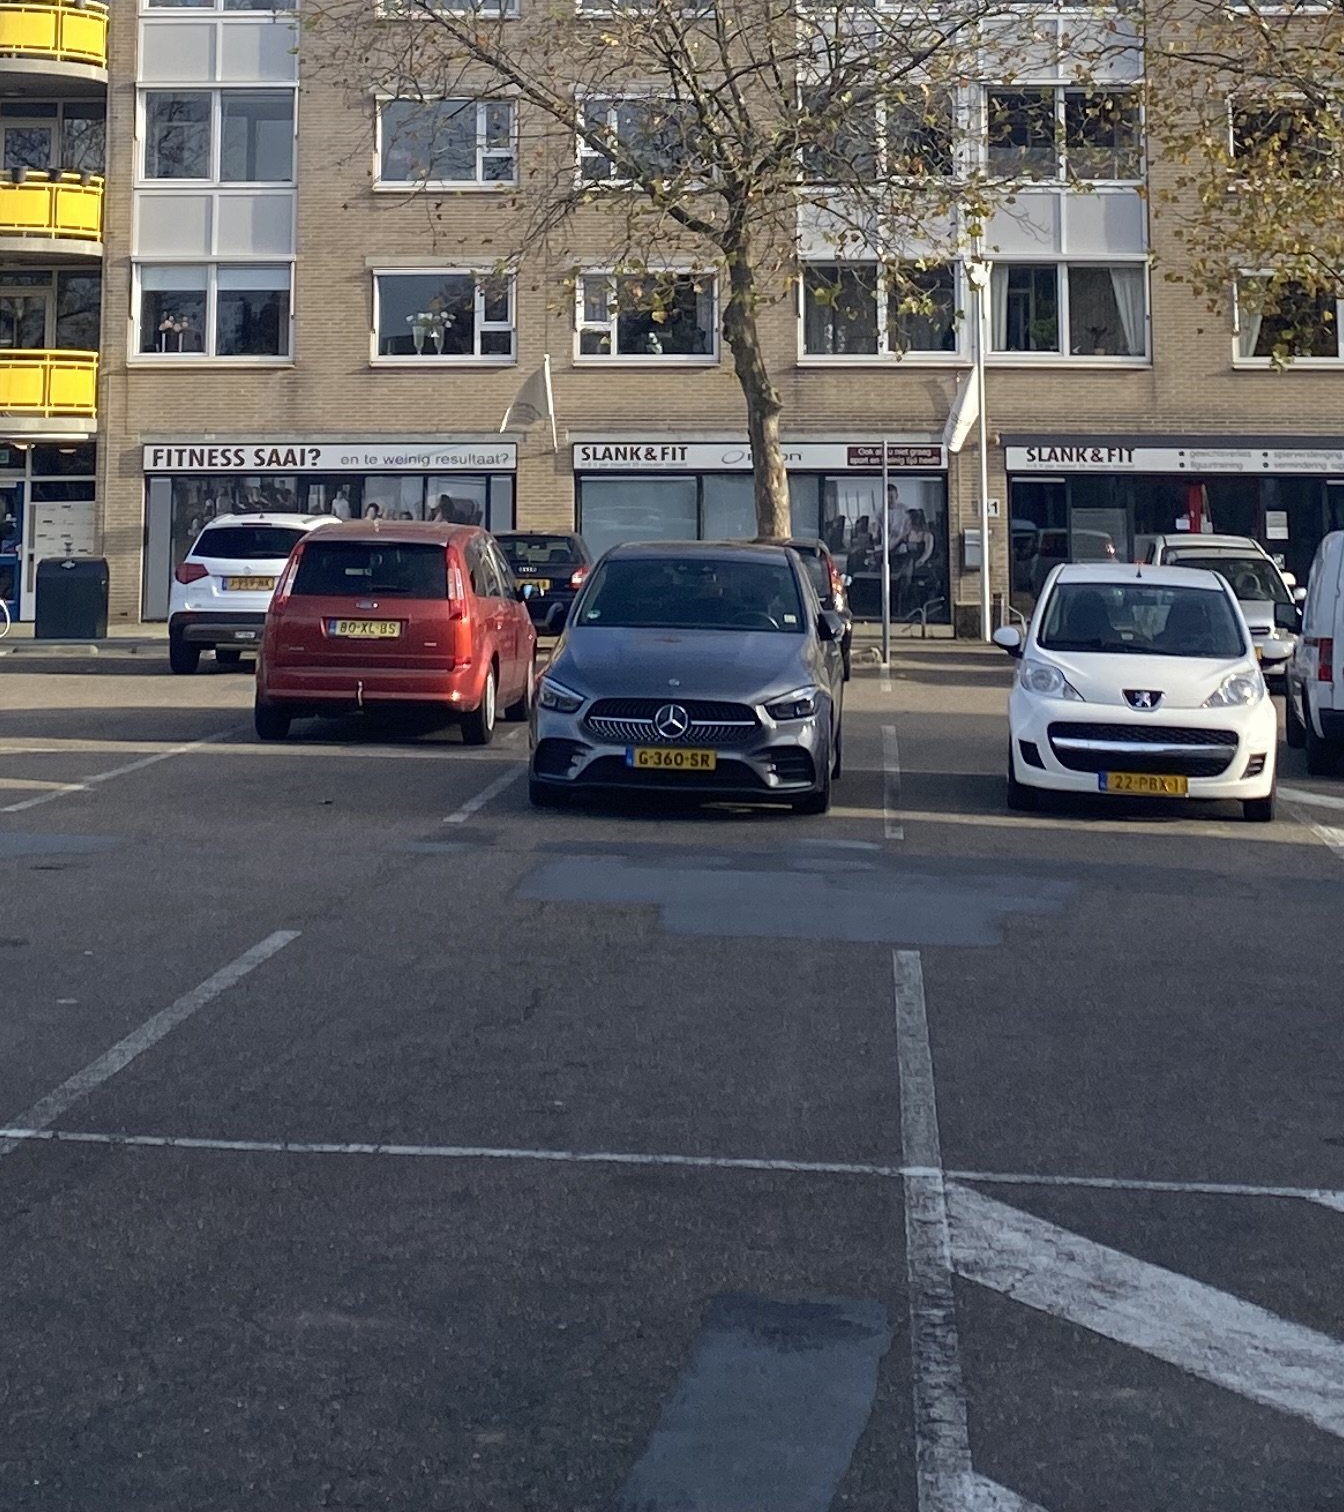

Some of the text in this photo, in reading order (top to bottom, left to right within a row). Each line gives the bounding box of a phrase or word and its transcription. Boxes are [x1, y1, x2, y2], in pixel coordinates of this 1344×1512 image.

[152, 448, 321, 467] FITNESS SAAI?
[340, 452, 509, 467] en te weinig resultaat?
[339, 621, 396, 635] 80-XL-BS
[638, 750, 710, 767] G-360-SR
